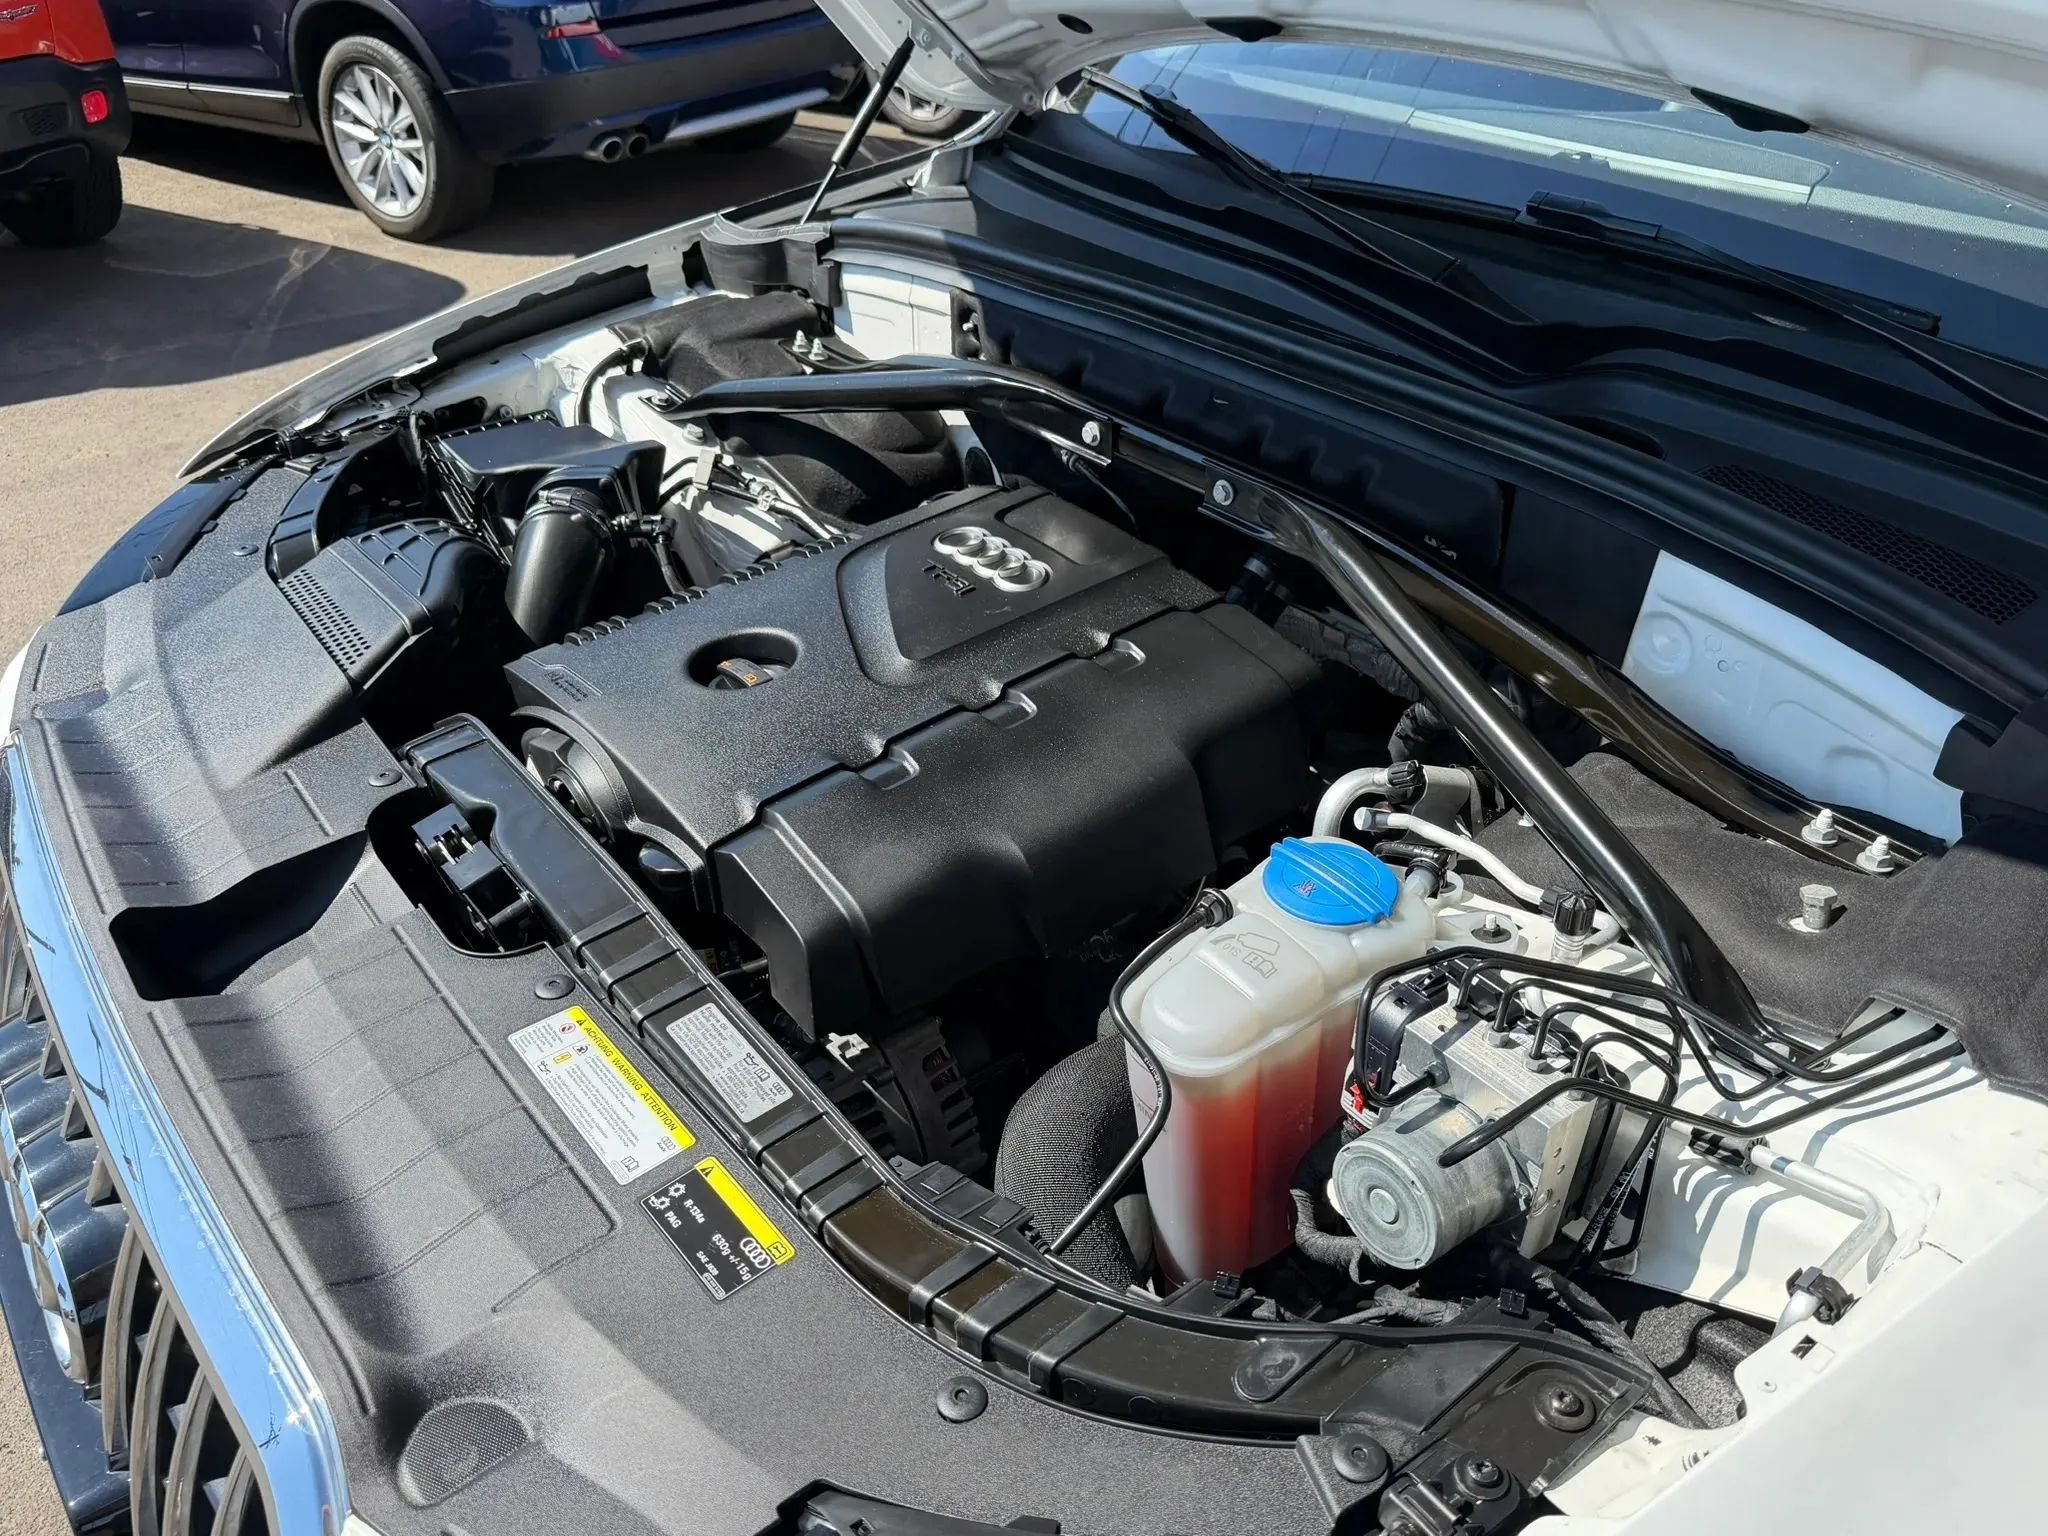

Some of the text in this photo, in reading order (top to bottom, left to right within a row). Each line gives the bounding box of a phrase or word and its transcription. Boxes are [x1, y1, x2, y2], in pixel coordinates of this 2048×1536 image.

[584, 1026, 614, 1057] ACHTUNG
[612, 1058, 643, 1091] WARNING
[641, 1092, 678, 1131] ATTENTION
[664, 1211, 682, 1228] PAG
[683, 1199, 705, 1224] R-134a
[712, 1233, 731, 1256] 630g
[696, 1251, 709, 1263] SAE
